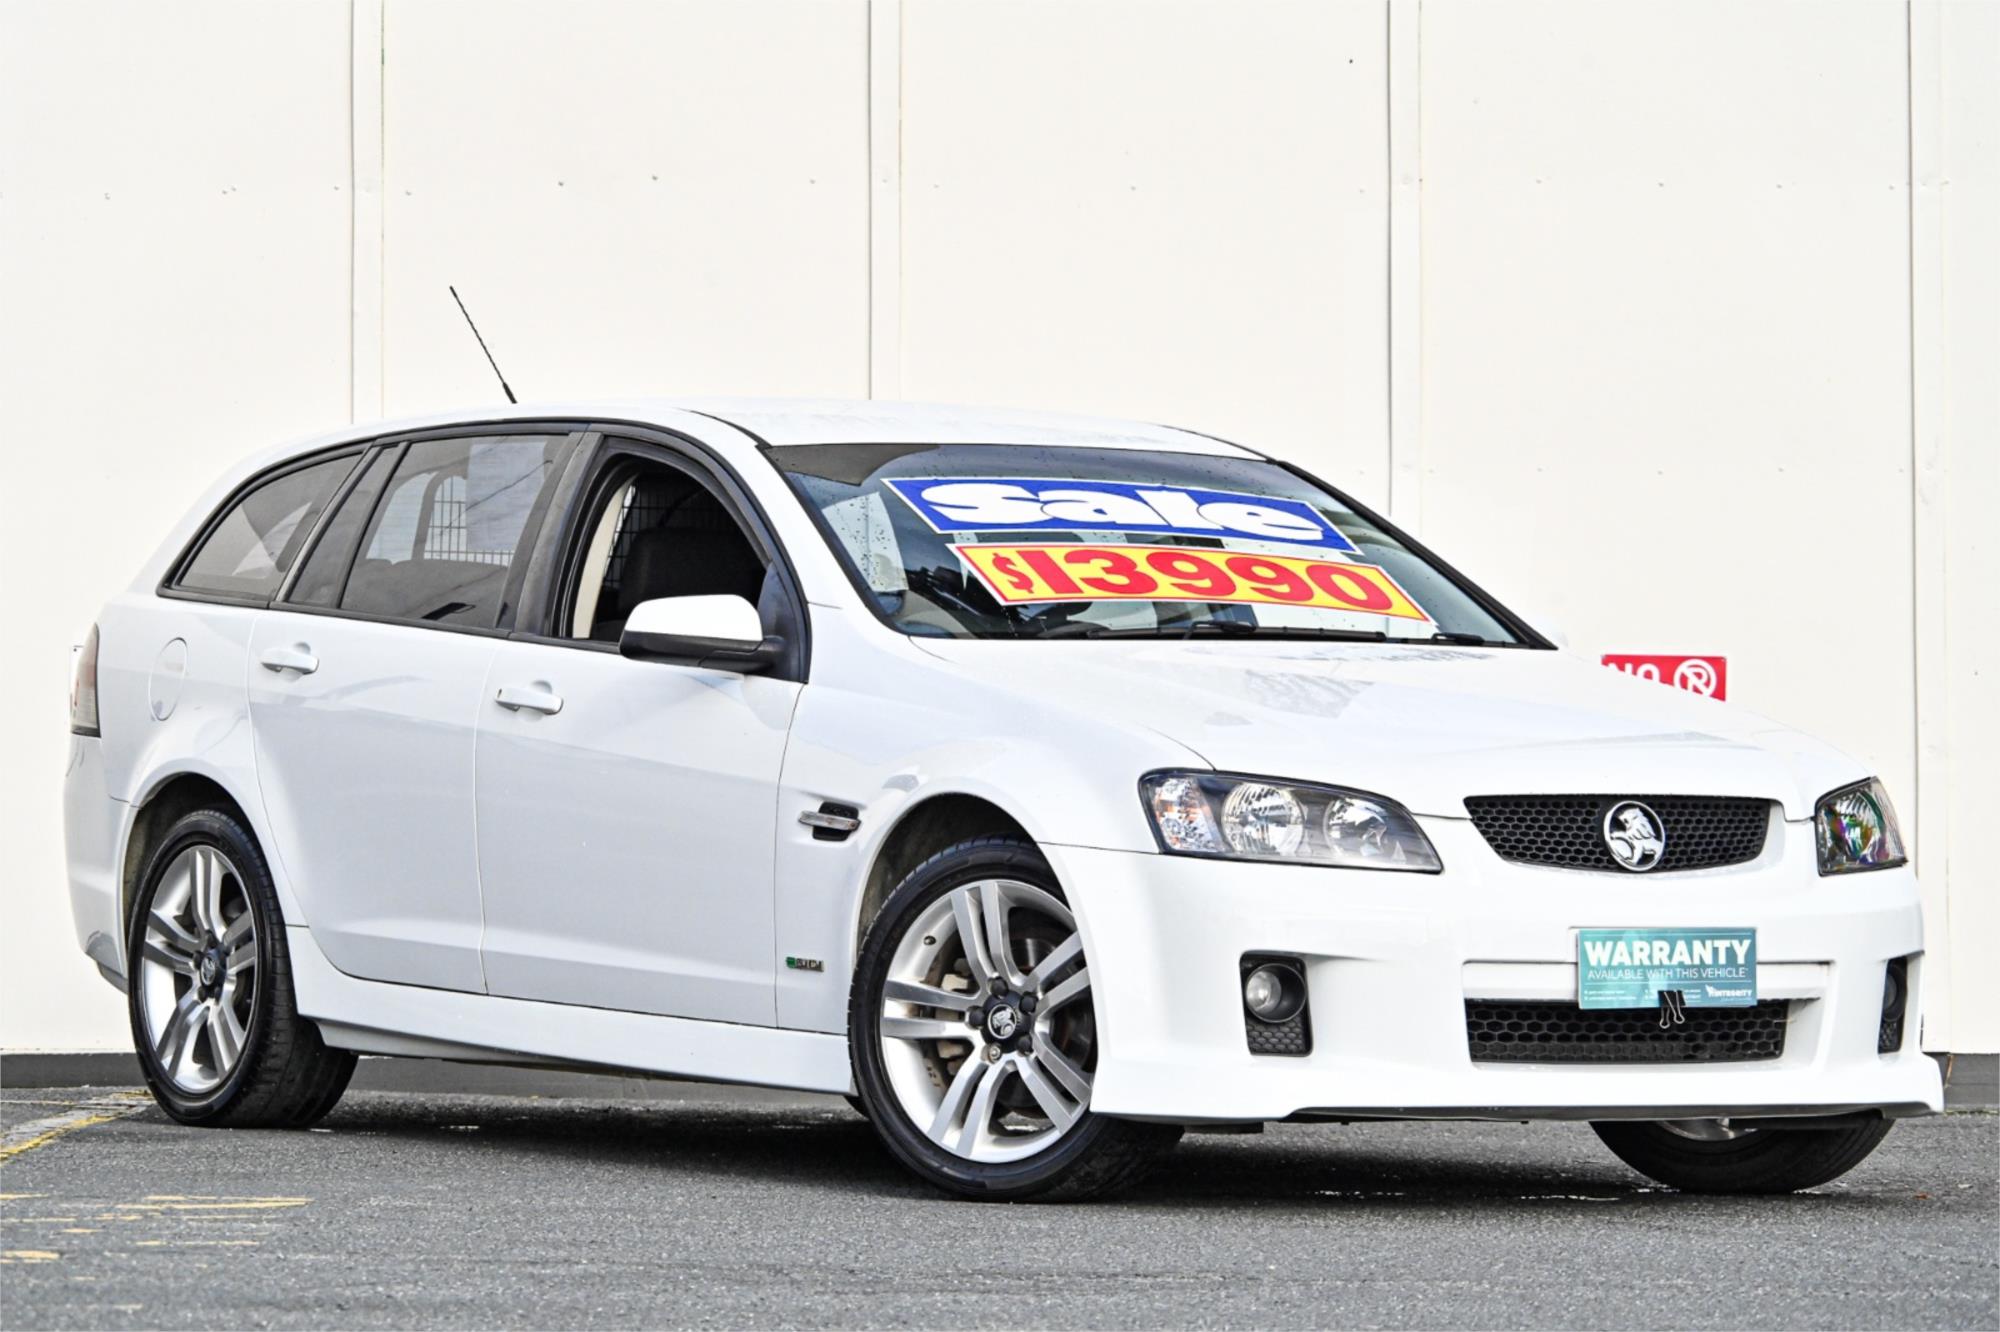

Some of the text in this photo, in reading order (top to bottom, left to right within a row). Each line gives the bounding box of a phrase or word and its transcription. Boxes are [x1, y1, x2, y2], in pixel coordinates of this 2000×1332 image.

[991, 548, 1393, 610] $13990
[1584, 939, 1752, 967] WARRANTY
[1587, 968, 1644, 980] AVAILABLE
[1646, 967, 1673, 979] WITH
[1676, 967, 1698, 979] THIS
